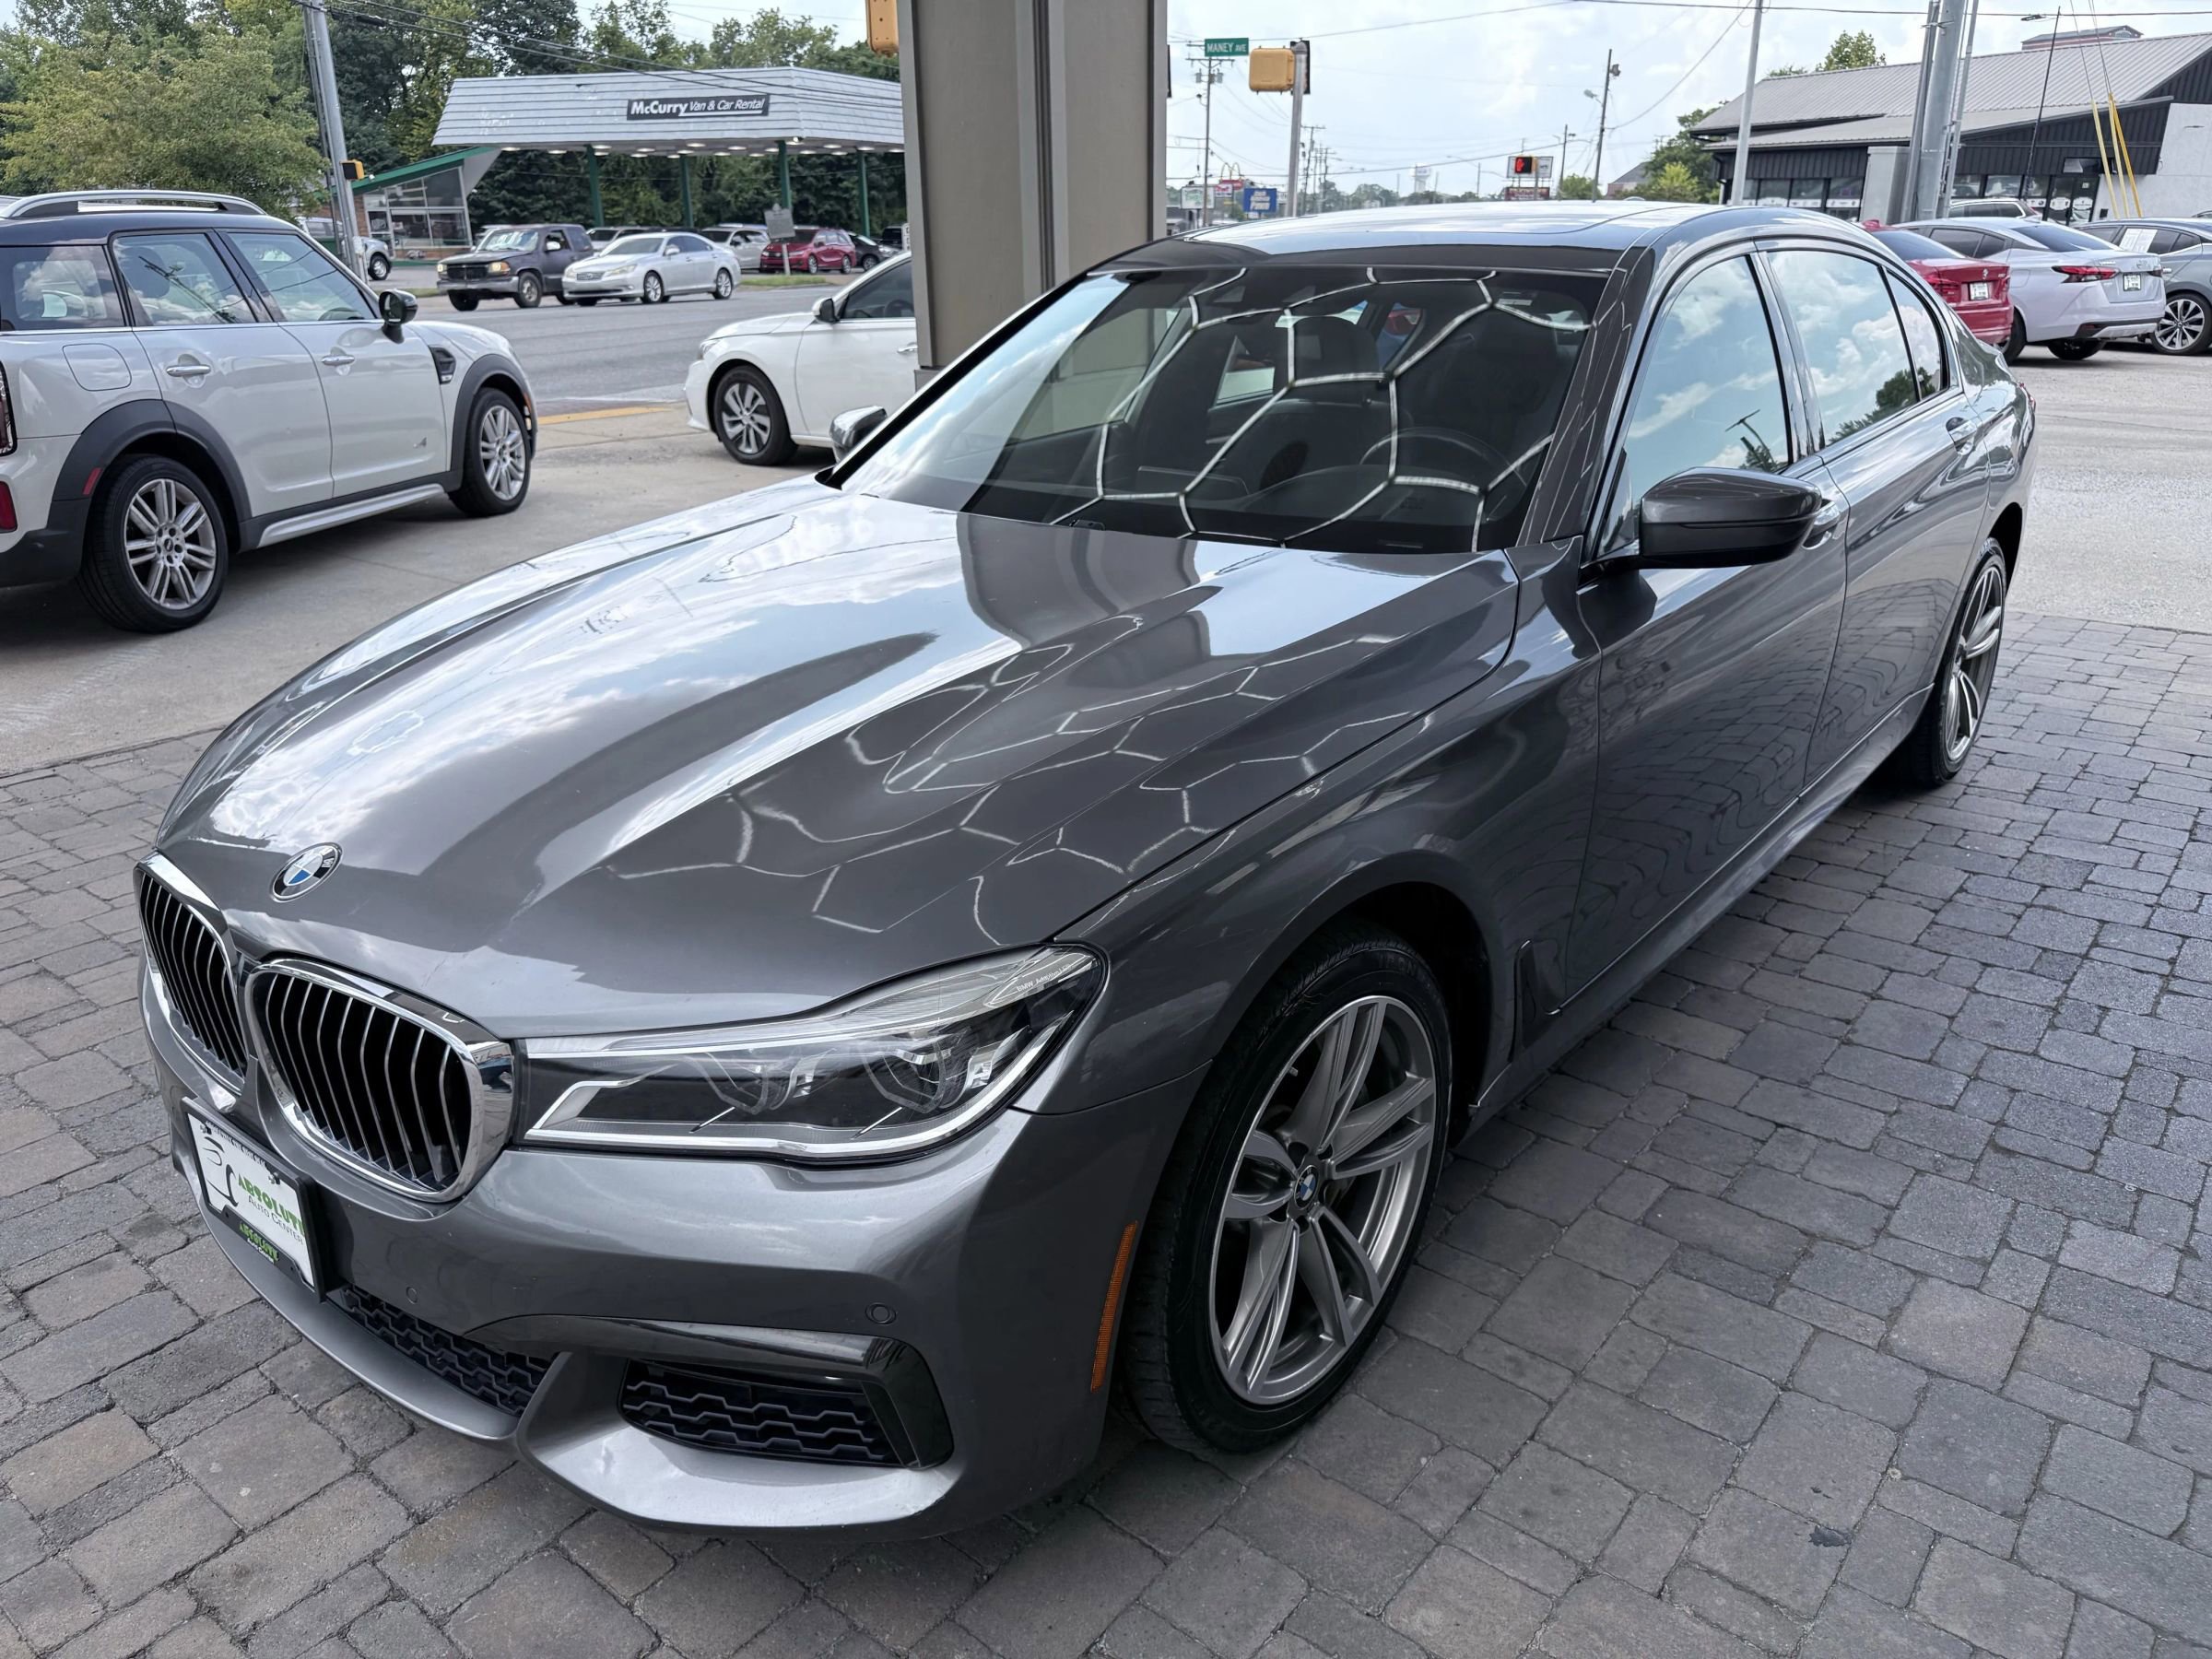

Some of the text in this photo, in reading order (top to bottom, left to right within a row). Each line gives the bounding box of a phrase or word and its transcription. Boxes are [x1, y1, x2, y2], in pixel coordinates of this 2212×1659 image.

[1206, 42, 1247, 53] MANEY AVE
[630, 98, 765, 116] McCurry Van & Car Rental
[248, 1194, 303, 1245] AUTO CENTER
